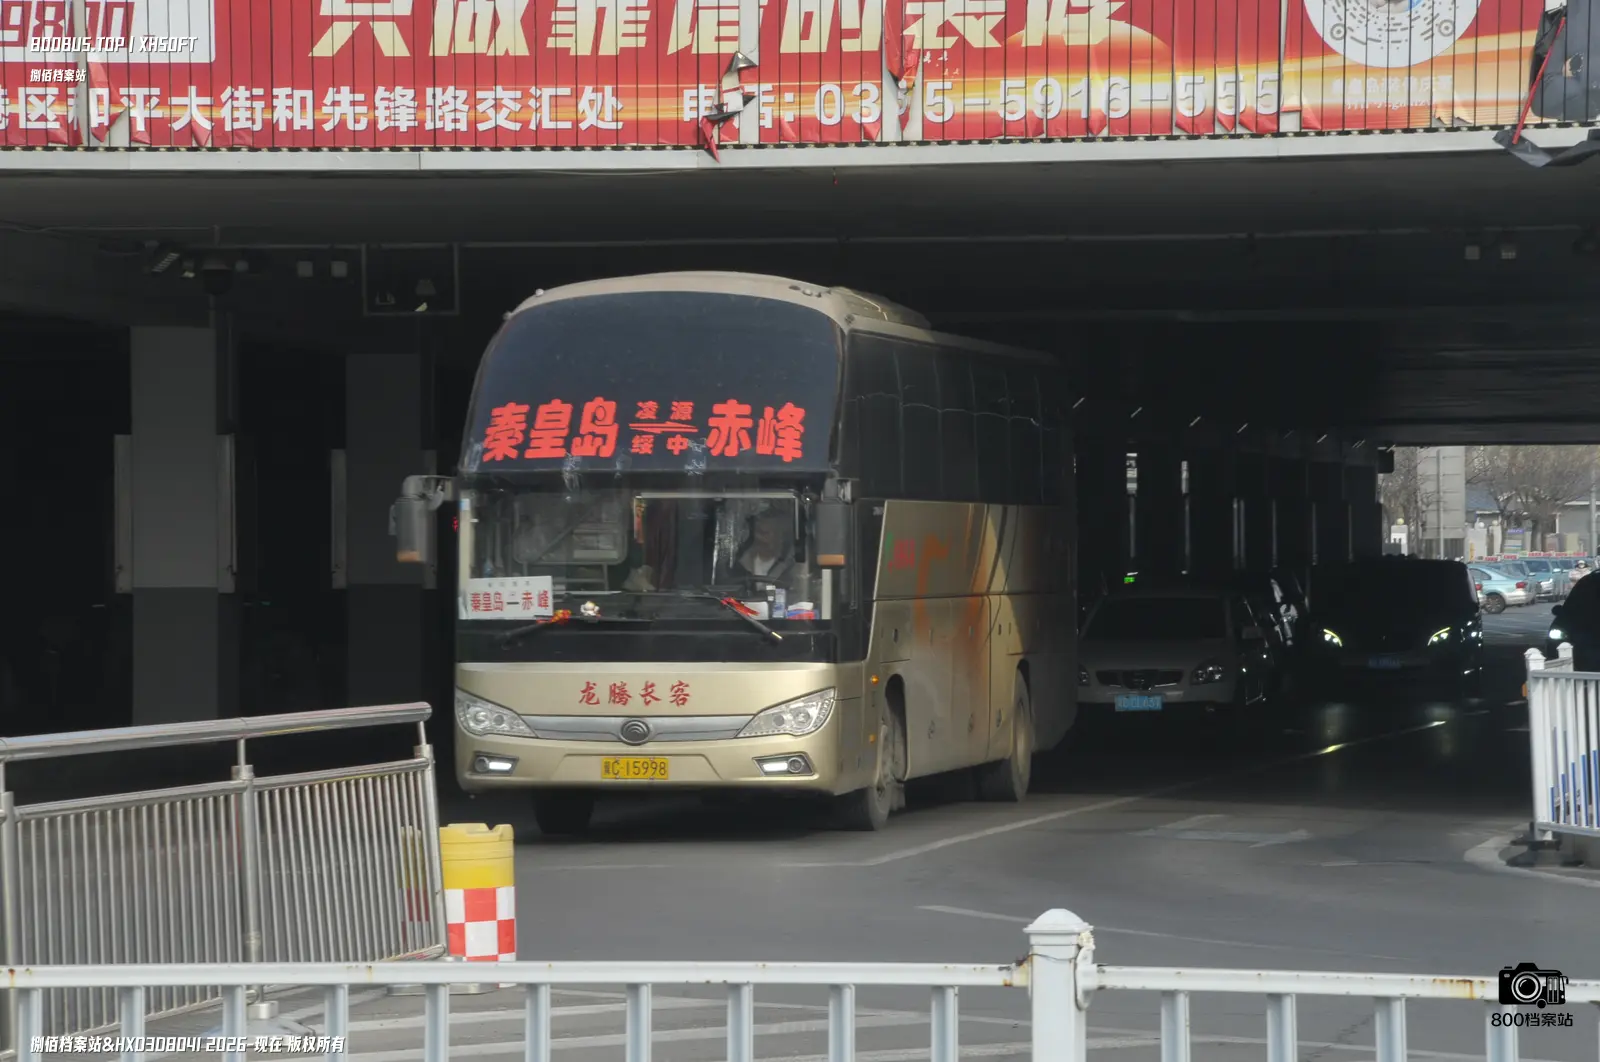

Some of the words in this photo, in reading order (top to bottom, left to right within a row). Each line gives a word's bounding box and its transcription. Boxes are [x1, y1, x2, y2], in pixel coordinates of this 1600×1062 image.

[482, 396, 620, 463] 秦皇岛
[706, 398, 806, 463] 赤峰
[578, 680, 692, 708] 龙腾长客
